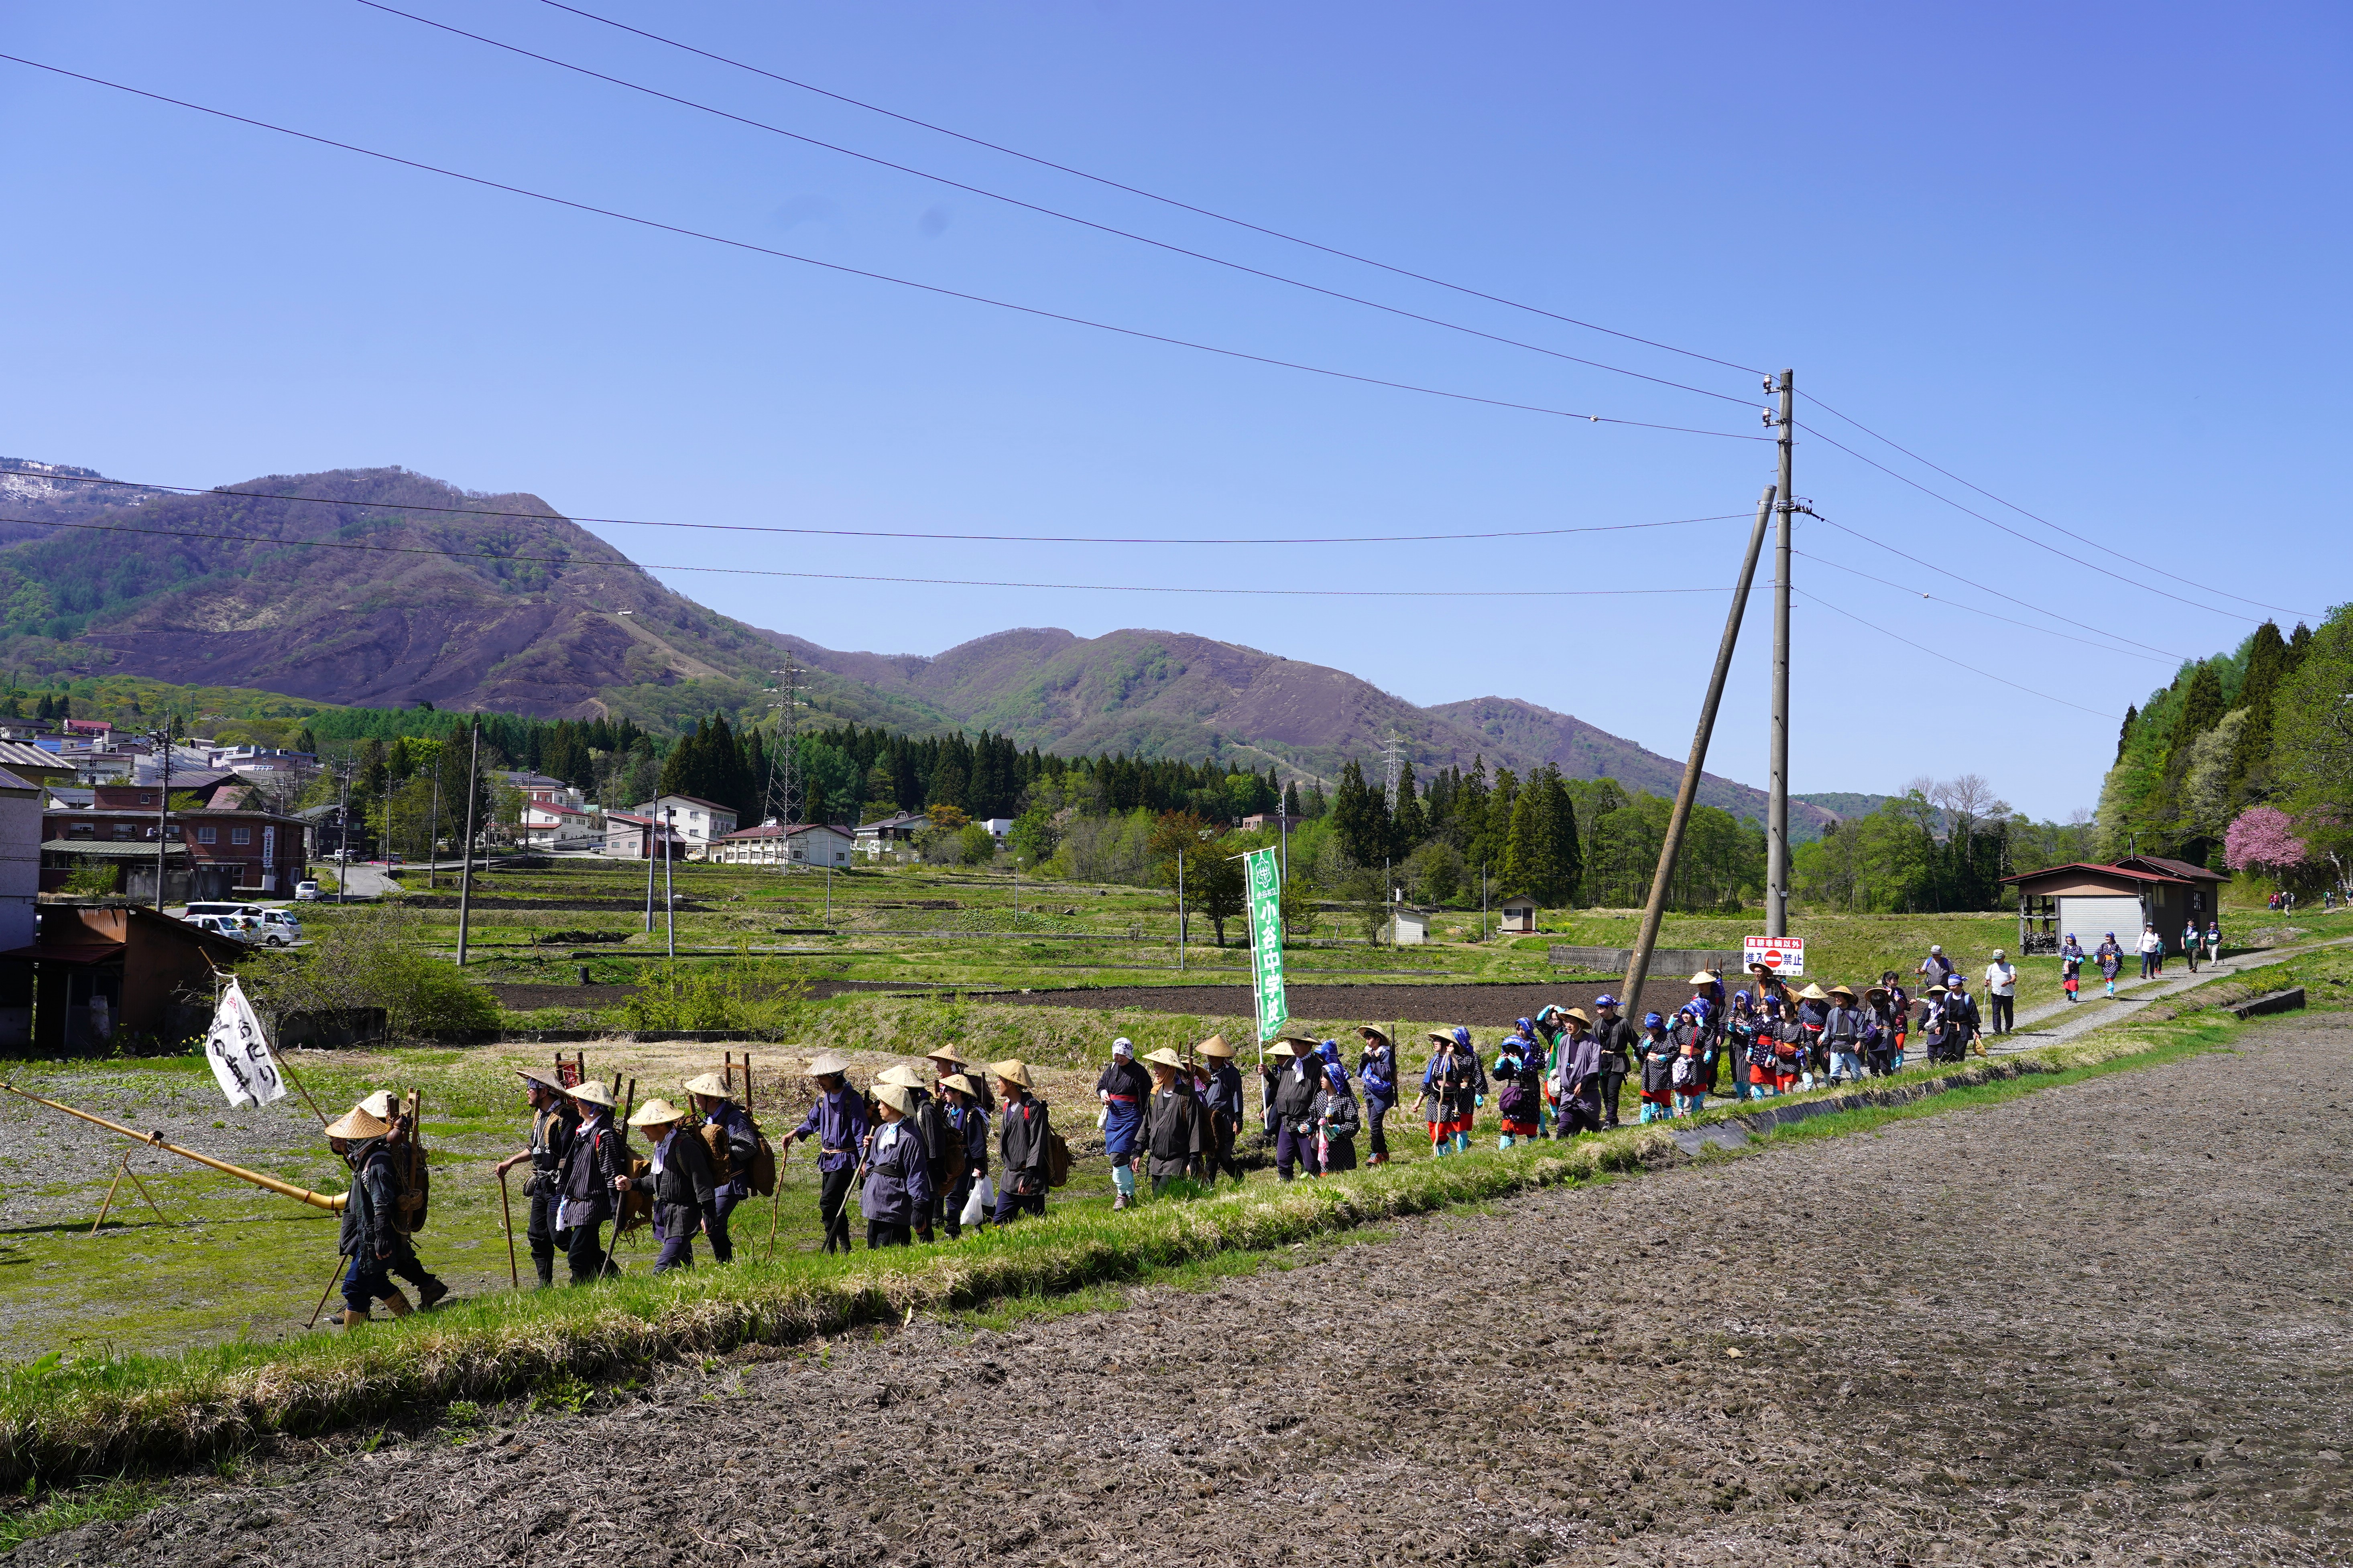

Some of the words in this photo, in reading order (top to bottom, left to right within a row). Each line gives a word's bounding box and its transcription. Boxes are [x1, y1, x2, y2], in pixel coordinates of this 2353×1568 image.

[1256, 887, 1278, 899] 小谷村立
[1259, 900, 1280, 1024] 小谷中学校
[1745, 952, 1763, 963] 進入
[1783, 953, 1802, 966] 禁止
